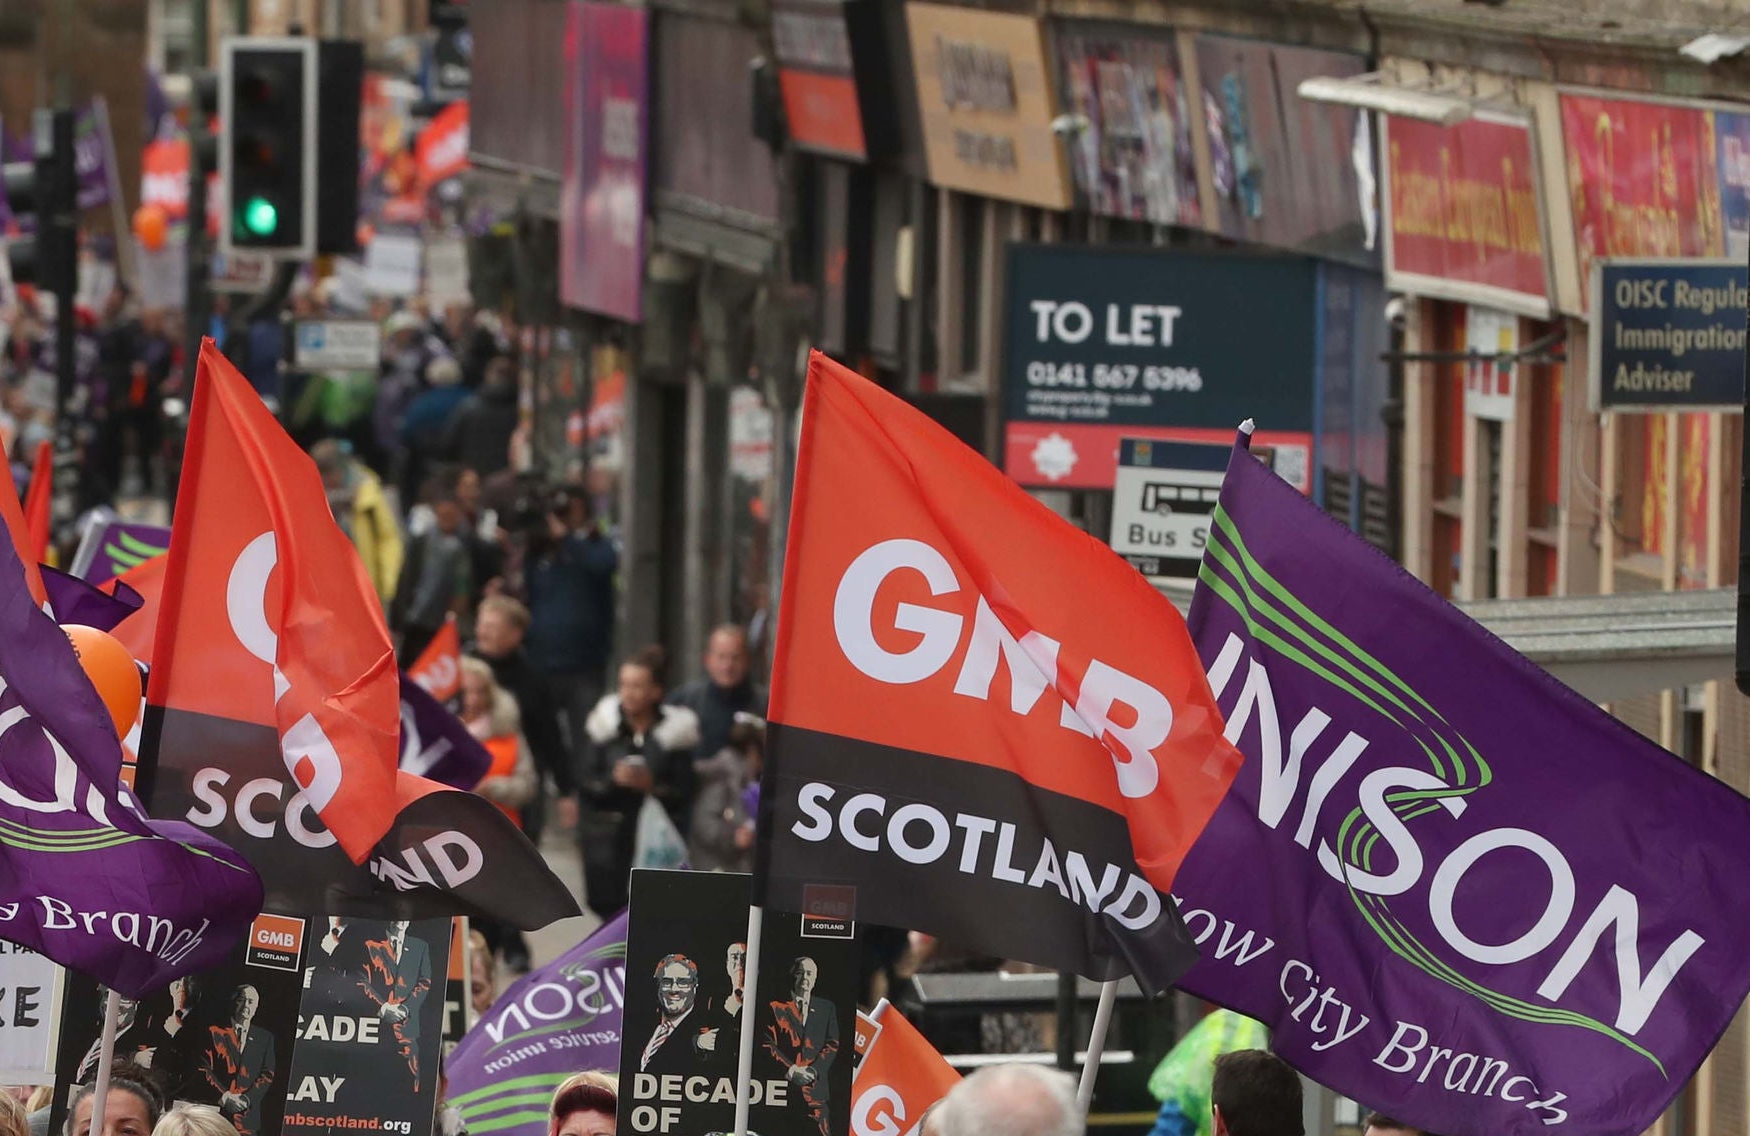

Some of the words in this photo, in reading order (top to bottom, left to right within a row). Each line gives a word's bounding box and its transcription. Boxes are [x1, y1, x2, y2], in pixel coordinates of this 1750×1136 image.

[1616, 280, 1668, 309] OISC
[1030, 301, 1093, 344] TO
[1106, 303, 1182, 347] LET
[1614, 363, 1695, 393] Adviser
[1128, 523, 1177, 548] Bus
[833, 538, 1173, 798] GMB
[790, 782, 1161, 935] SCOTLAND
[35, 893, 211, 966] Branch
[256, 929, 295, 947] GMB
[810, 922, 845, 931] SCOTLAND
[256, 951, 291, 963] SCOTLAND
[1279, 957, 1371, 1052] City
[1372, 1019, 1570, 1126] Branch
[630, 1105, 682, 1133] OF
